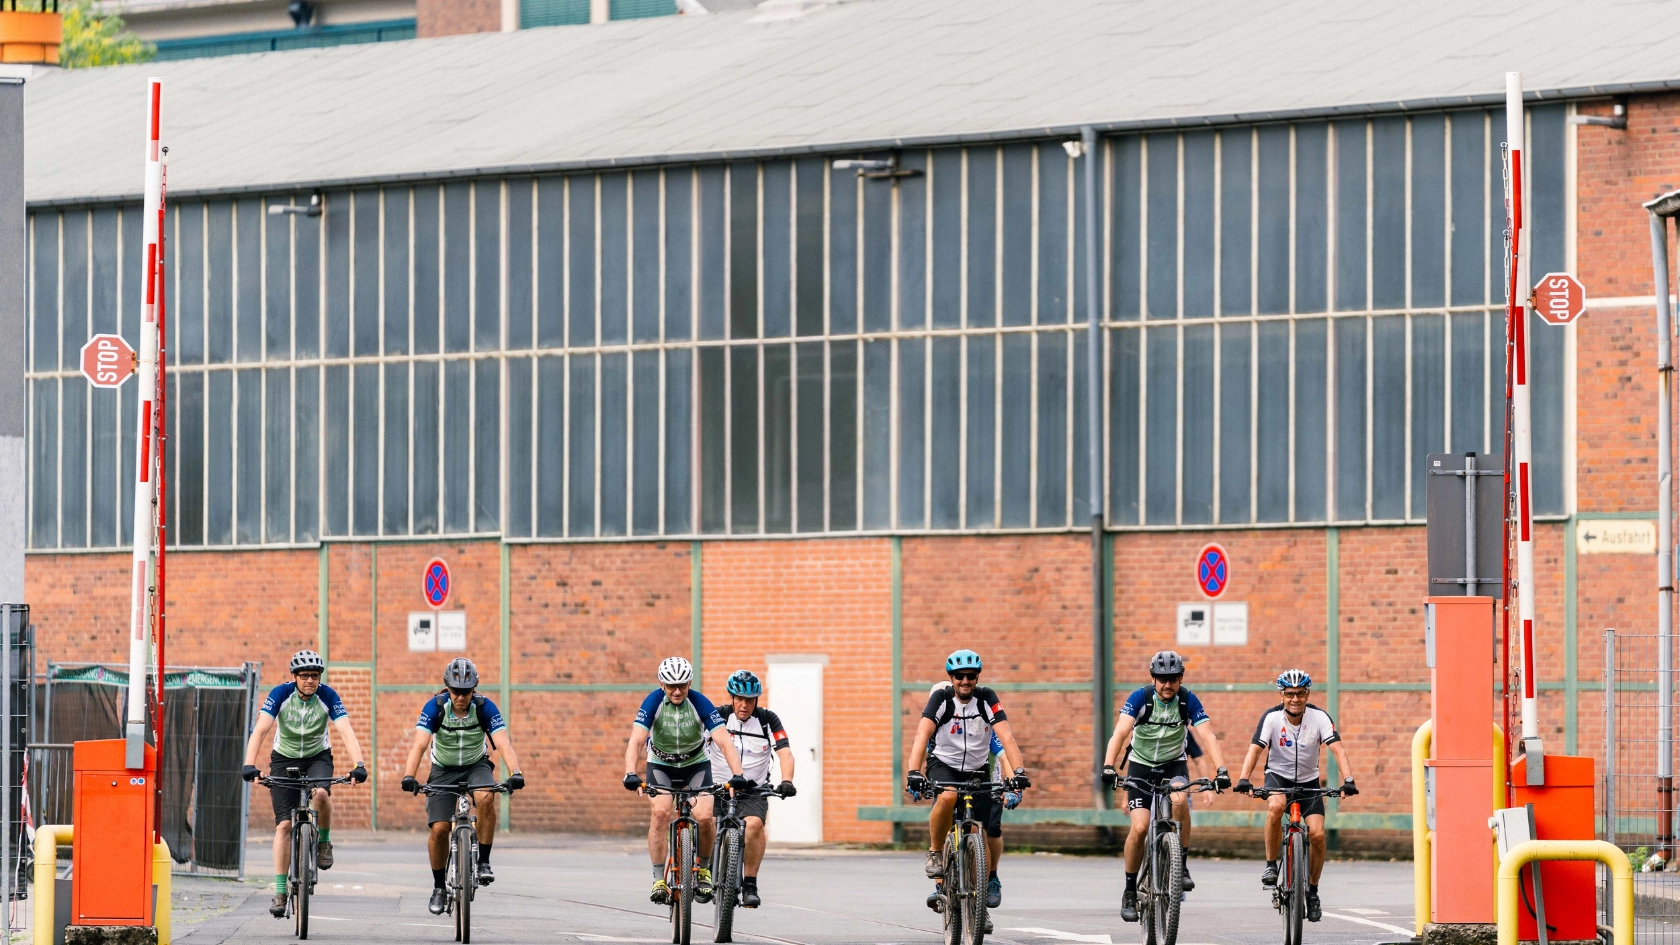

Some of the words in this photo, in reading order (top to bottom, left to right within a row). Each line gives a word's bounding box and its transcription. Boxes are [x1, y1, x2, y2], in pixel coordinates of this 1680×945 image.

[1549, 278, 1570, 320] STOP
[96, 340, 119, 383] STOP
[1601, 529, 1651, 544] Ausfahrt
[187, 673, 225, 685] EMERGENCY
